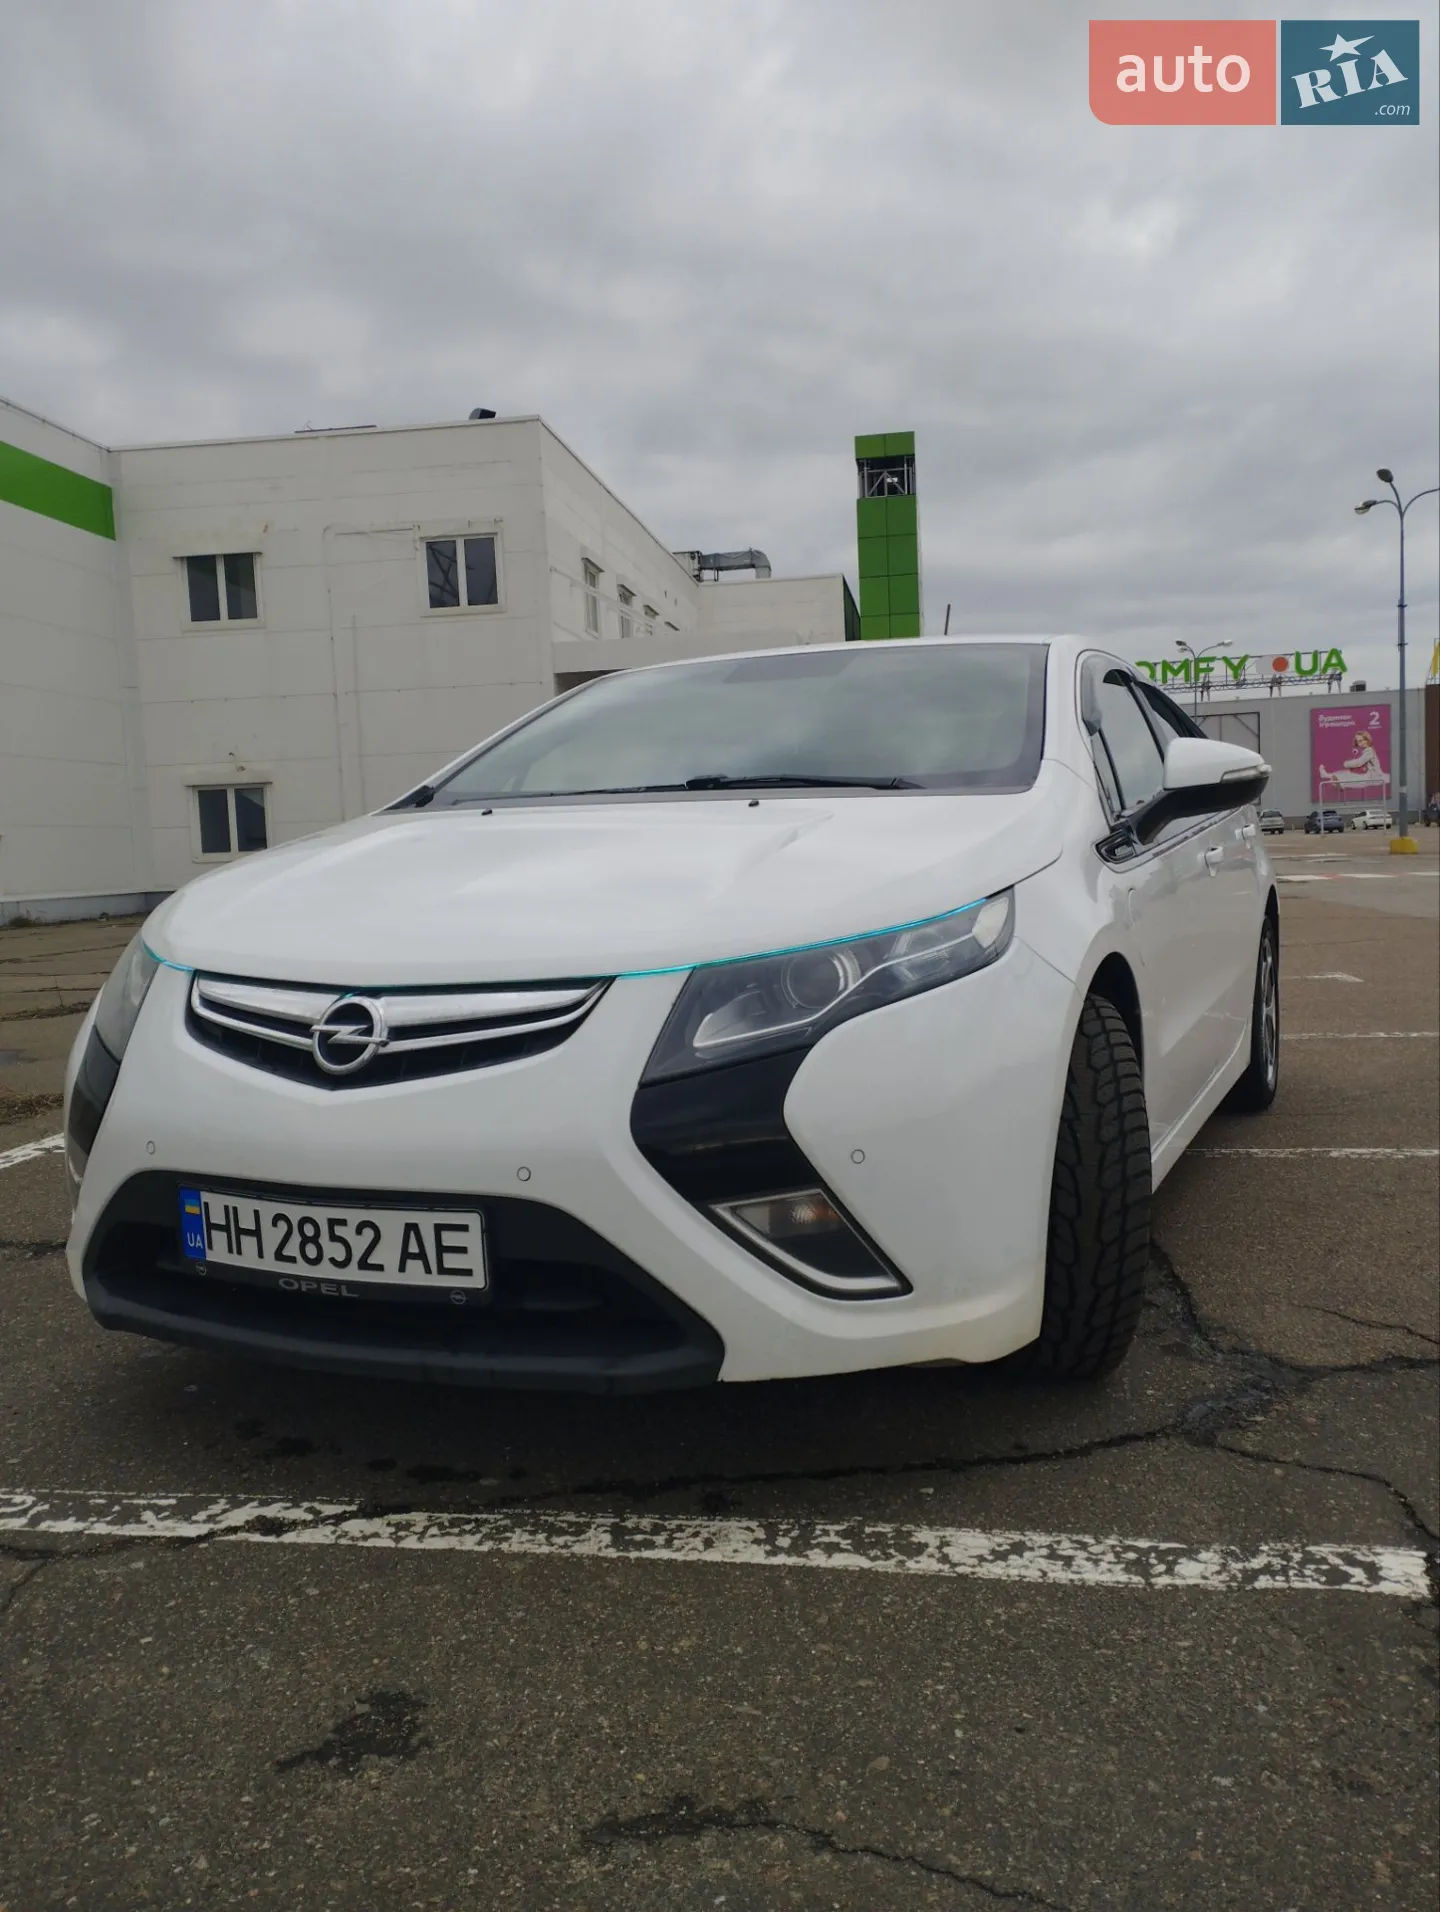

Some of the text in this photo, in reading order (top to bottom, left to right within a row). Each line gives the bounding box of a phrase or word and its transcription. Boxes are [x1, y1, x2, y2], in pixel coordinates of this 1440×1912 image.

[1294, 647, 1348, 677] UA
[1369, 711, 1380, 726] 2
[188, 1232, 203, 1250] UA
[203, 1202, 474, 1277] HH 2852 AE
[279, 1278, 359, 1299] OPEL
